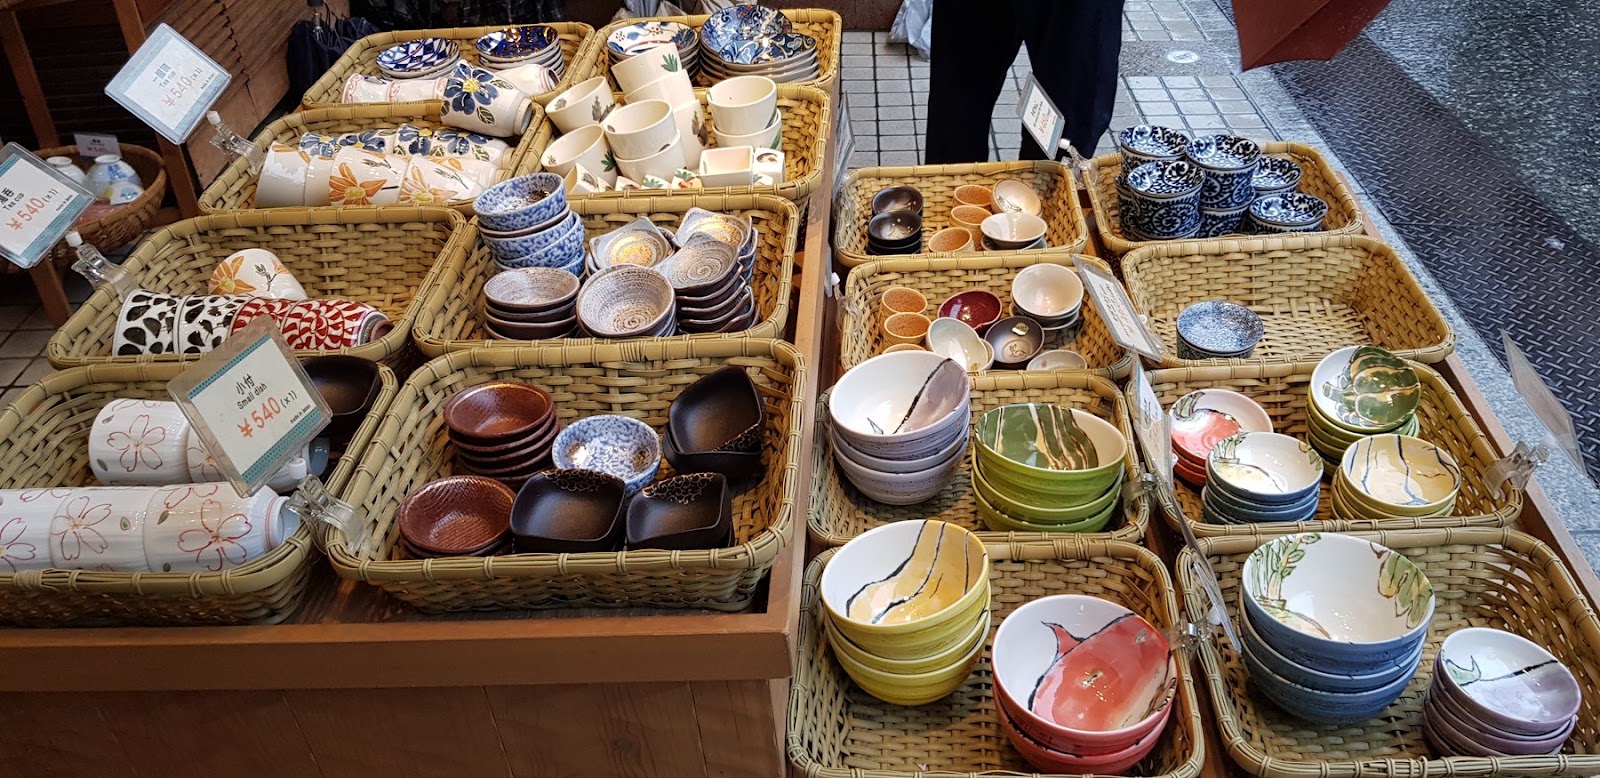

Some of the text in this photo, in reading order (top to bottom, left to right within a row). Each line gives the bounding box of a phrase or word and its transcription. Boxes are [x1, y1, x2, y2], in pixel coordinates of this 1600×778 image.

[236, 373, 255, 395] 小付
[236, 382, 268, 410] Small dish
[237, 396, 281, 438] ¥540
